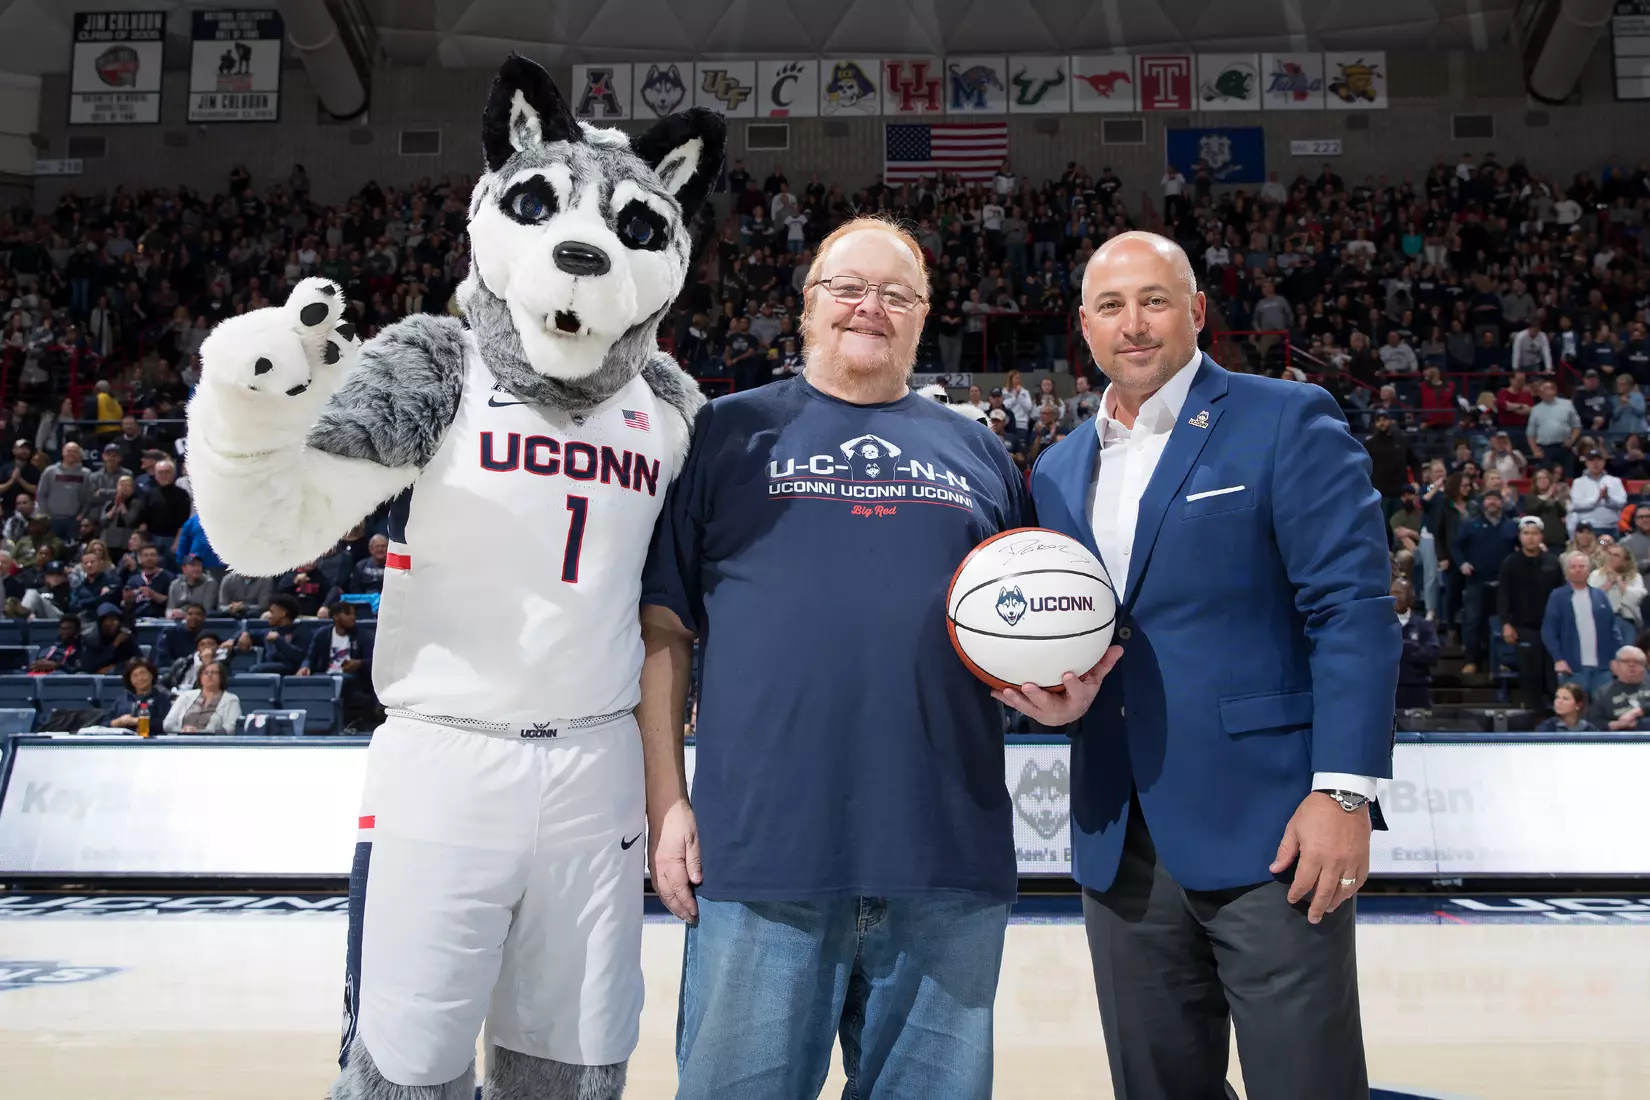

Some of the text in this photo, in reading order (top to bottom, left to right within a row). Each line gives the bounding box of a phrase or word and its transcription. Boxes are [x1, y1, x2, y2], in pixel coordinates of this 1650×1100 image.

[198, 95, 216, 109] JIM
[702, 69, 752, 111] UCF
[480, 431, 660, 496] UCONN
[768, 481, 973, 508] UCONN! UCONN! UCONN!
[851, 505, 896, 517] Big Red
[561, 494, 588, 583] 1
[520, 728, 558, 738] UCONN
